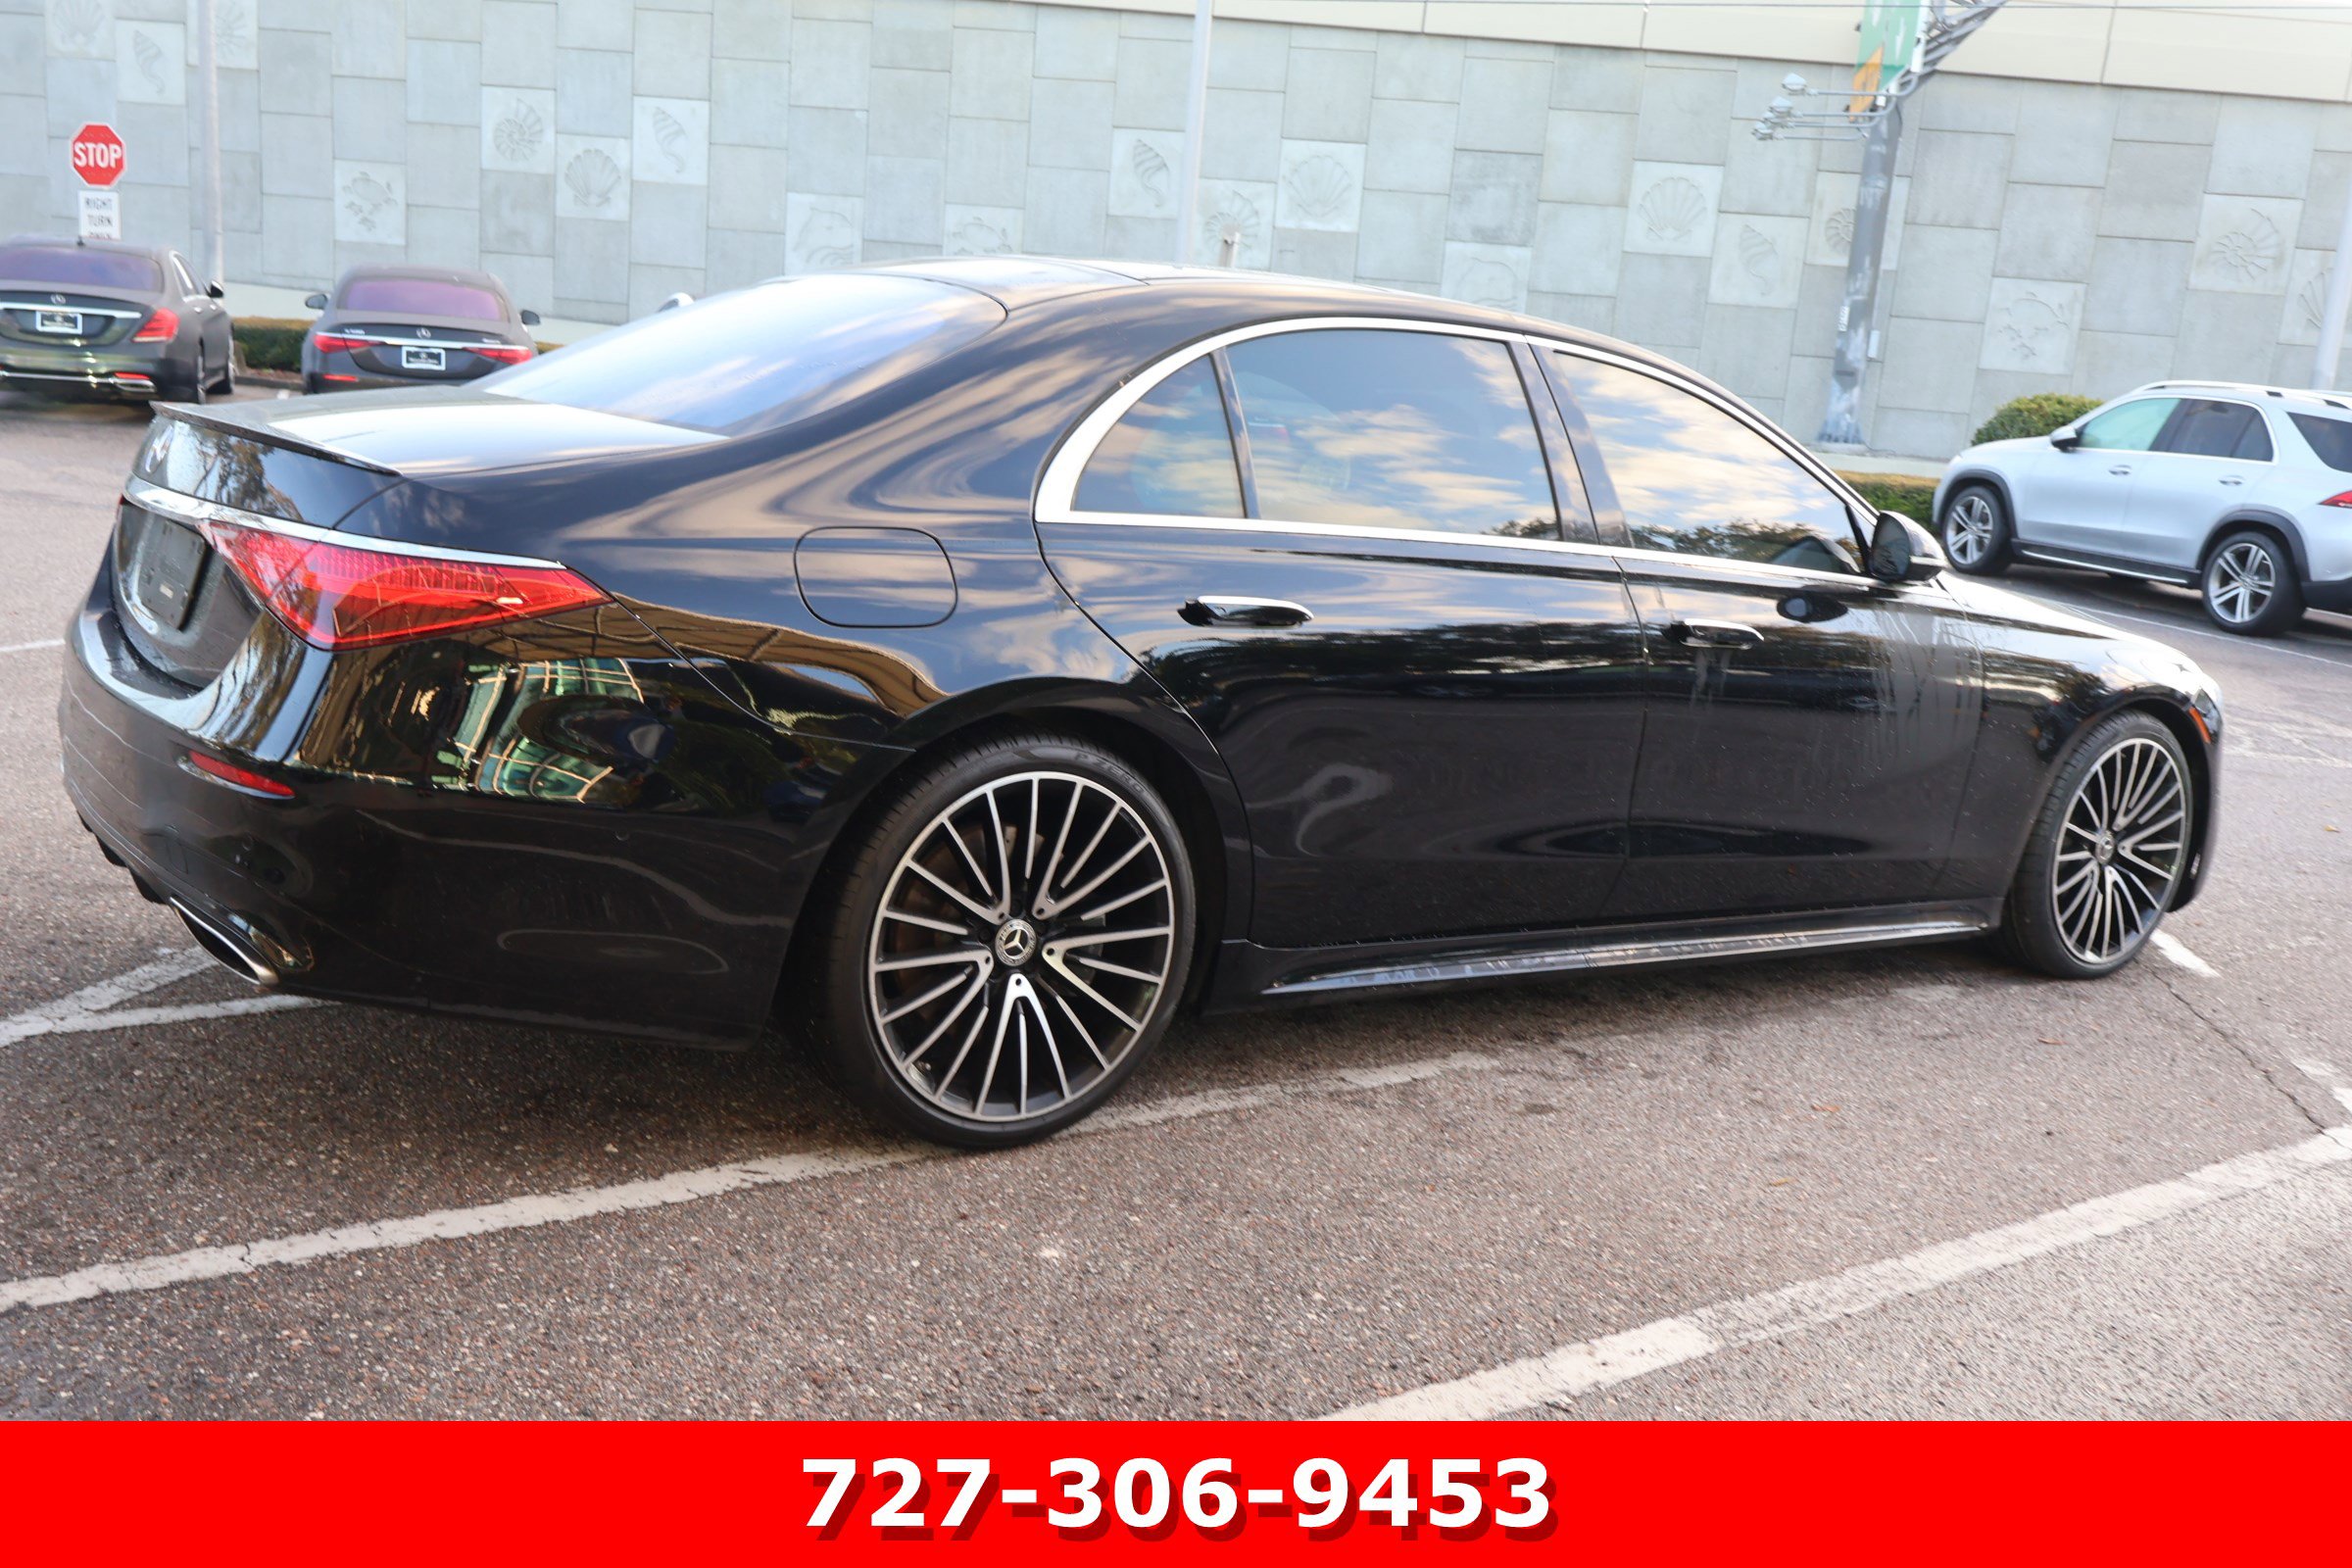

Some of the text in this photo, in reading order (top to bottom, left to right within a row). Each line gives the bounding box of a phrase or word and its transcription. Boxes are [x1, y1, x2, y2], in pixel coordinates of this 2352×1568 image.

[74, 141, 122, 169] STOP
[85, 197, 113, 211] RIGHT
[87, 215, 113, 227] TURN
